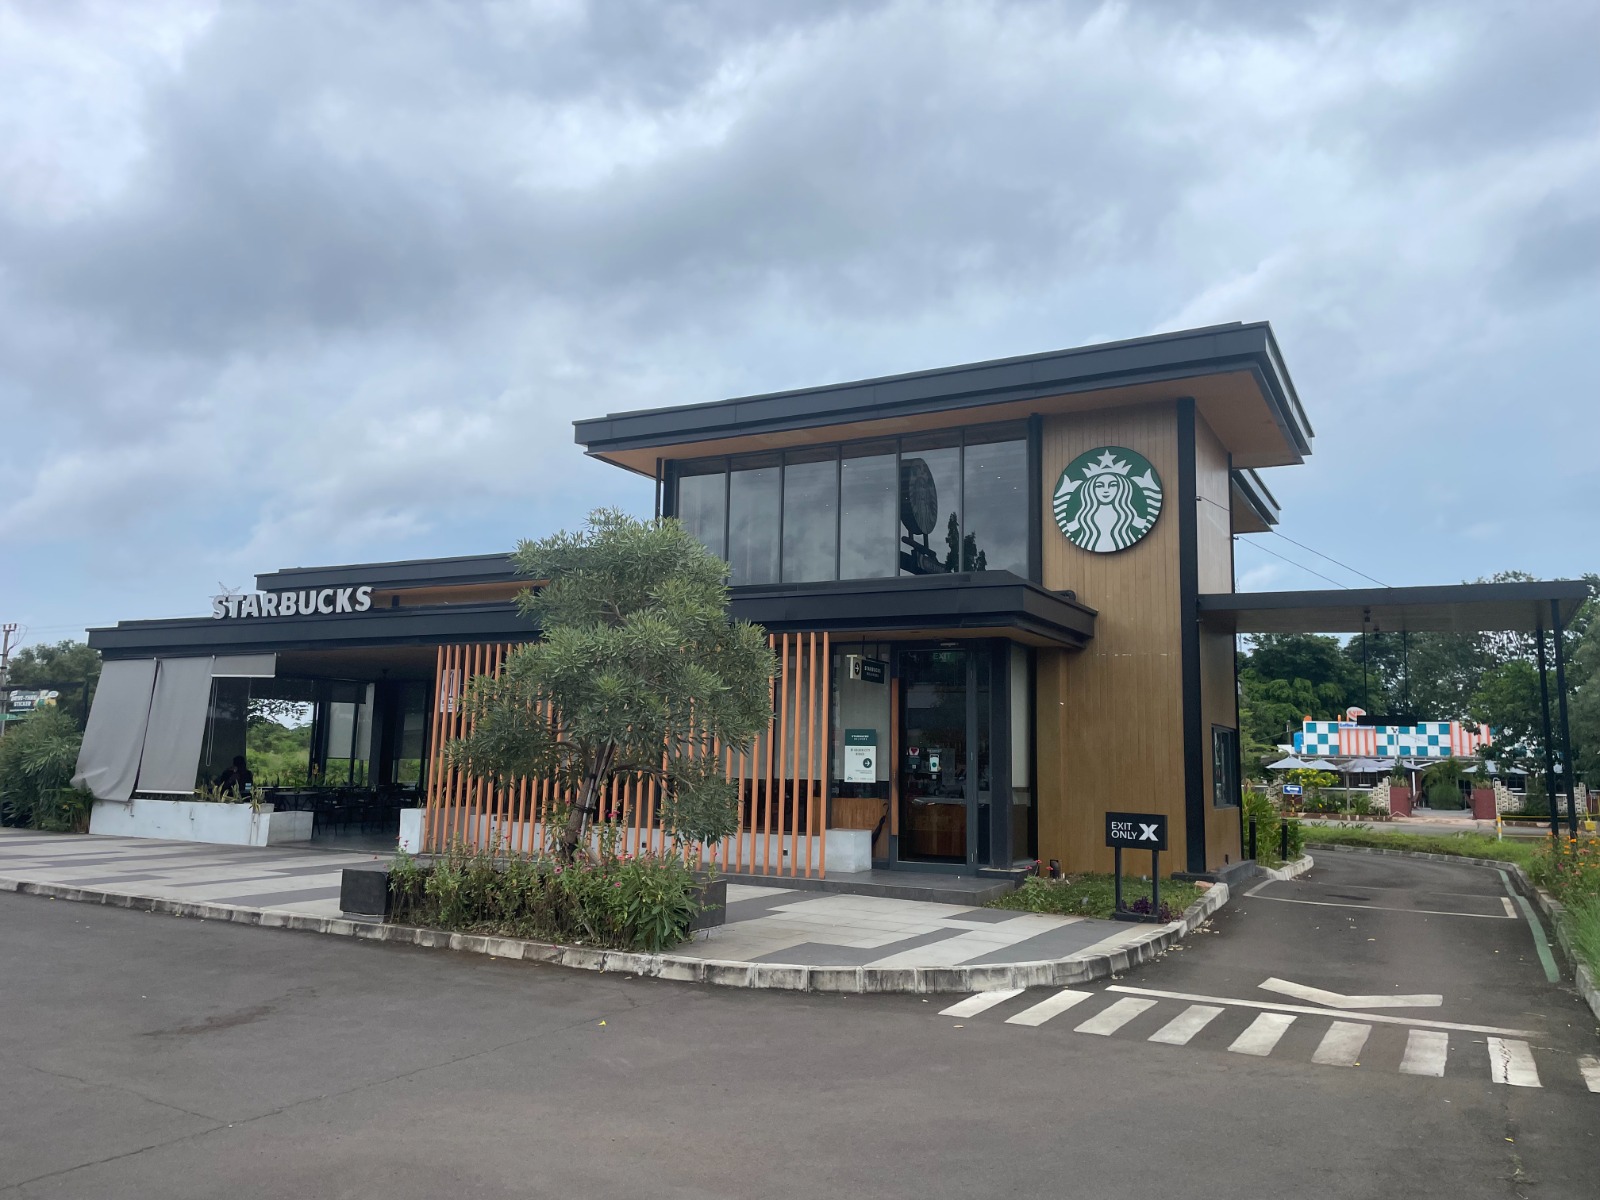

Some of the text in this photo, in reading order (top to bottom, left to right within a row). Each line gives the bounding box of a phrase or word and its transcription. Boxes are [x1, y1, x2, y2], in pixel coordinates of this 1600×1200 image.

[212, 586, 374, 620] STARBUCKS
[933, 652, 952, 660] EXIT
[1111, 821, 1133, 831] EXIT
[1111, 830, 1138, 840] ONLY
